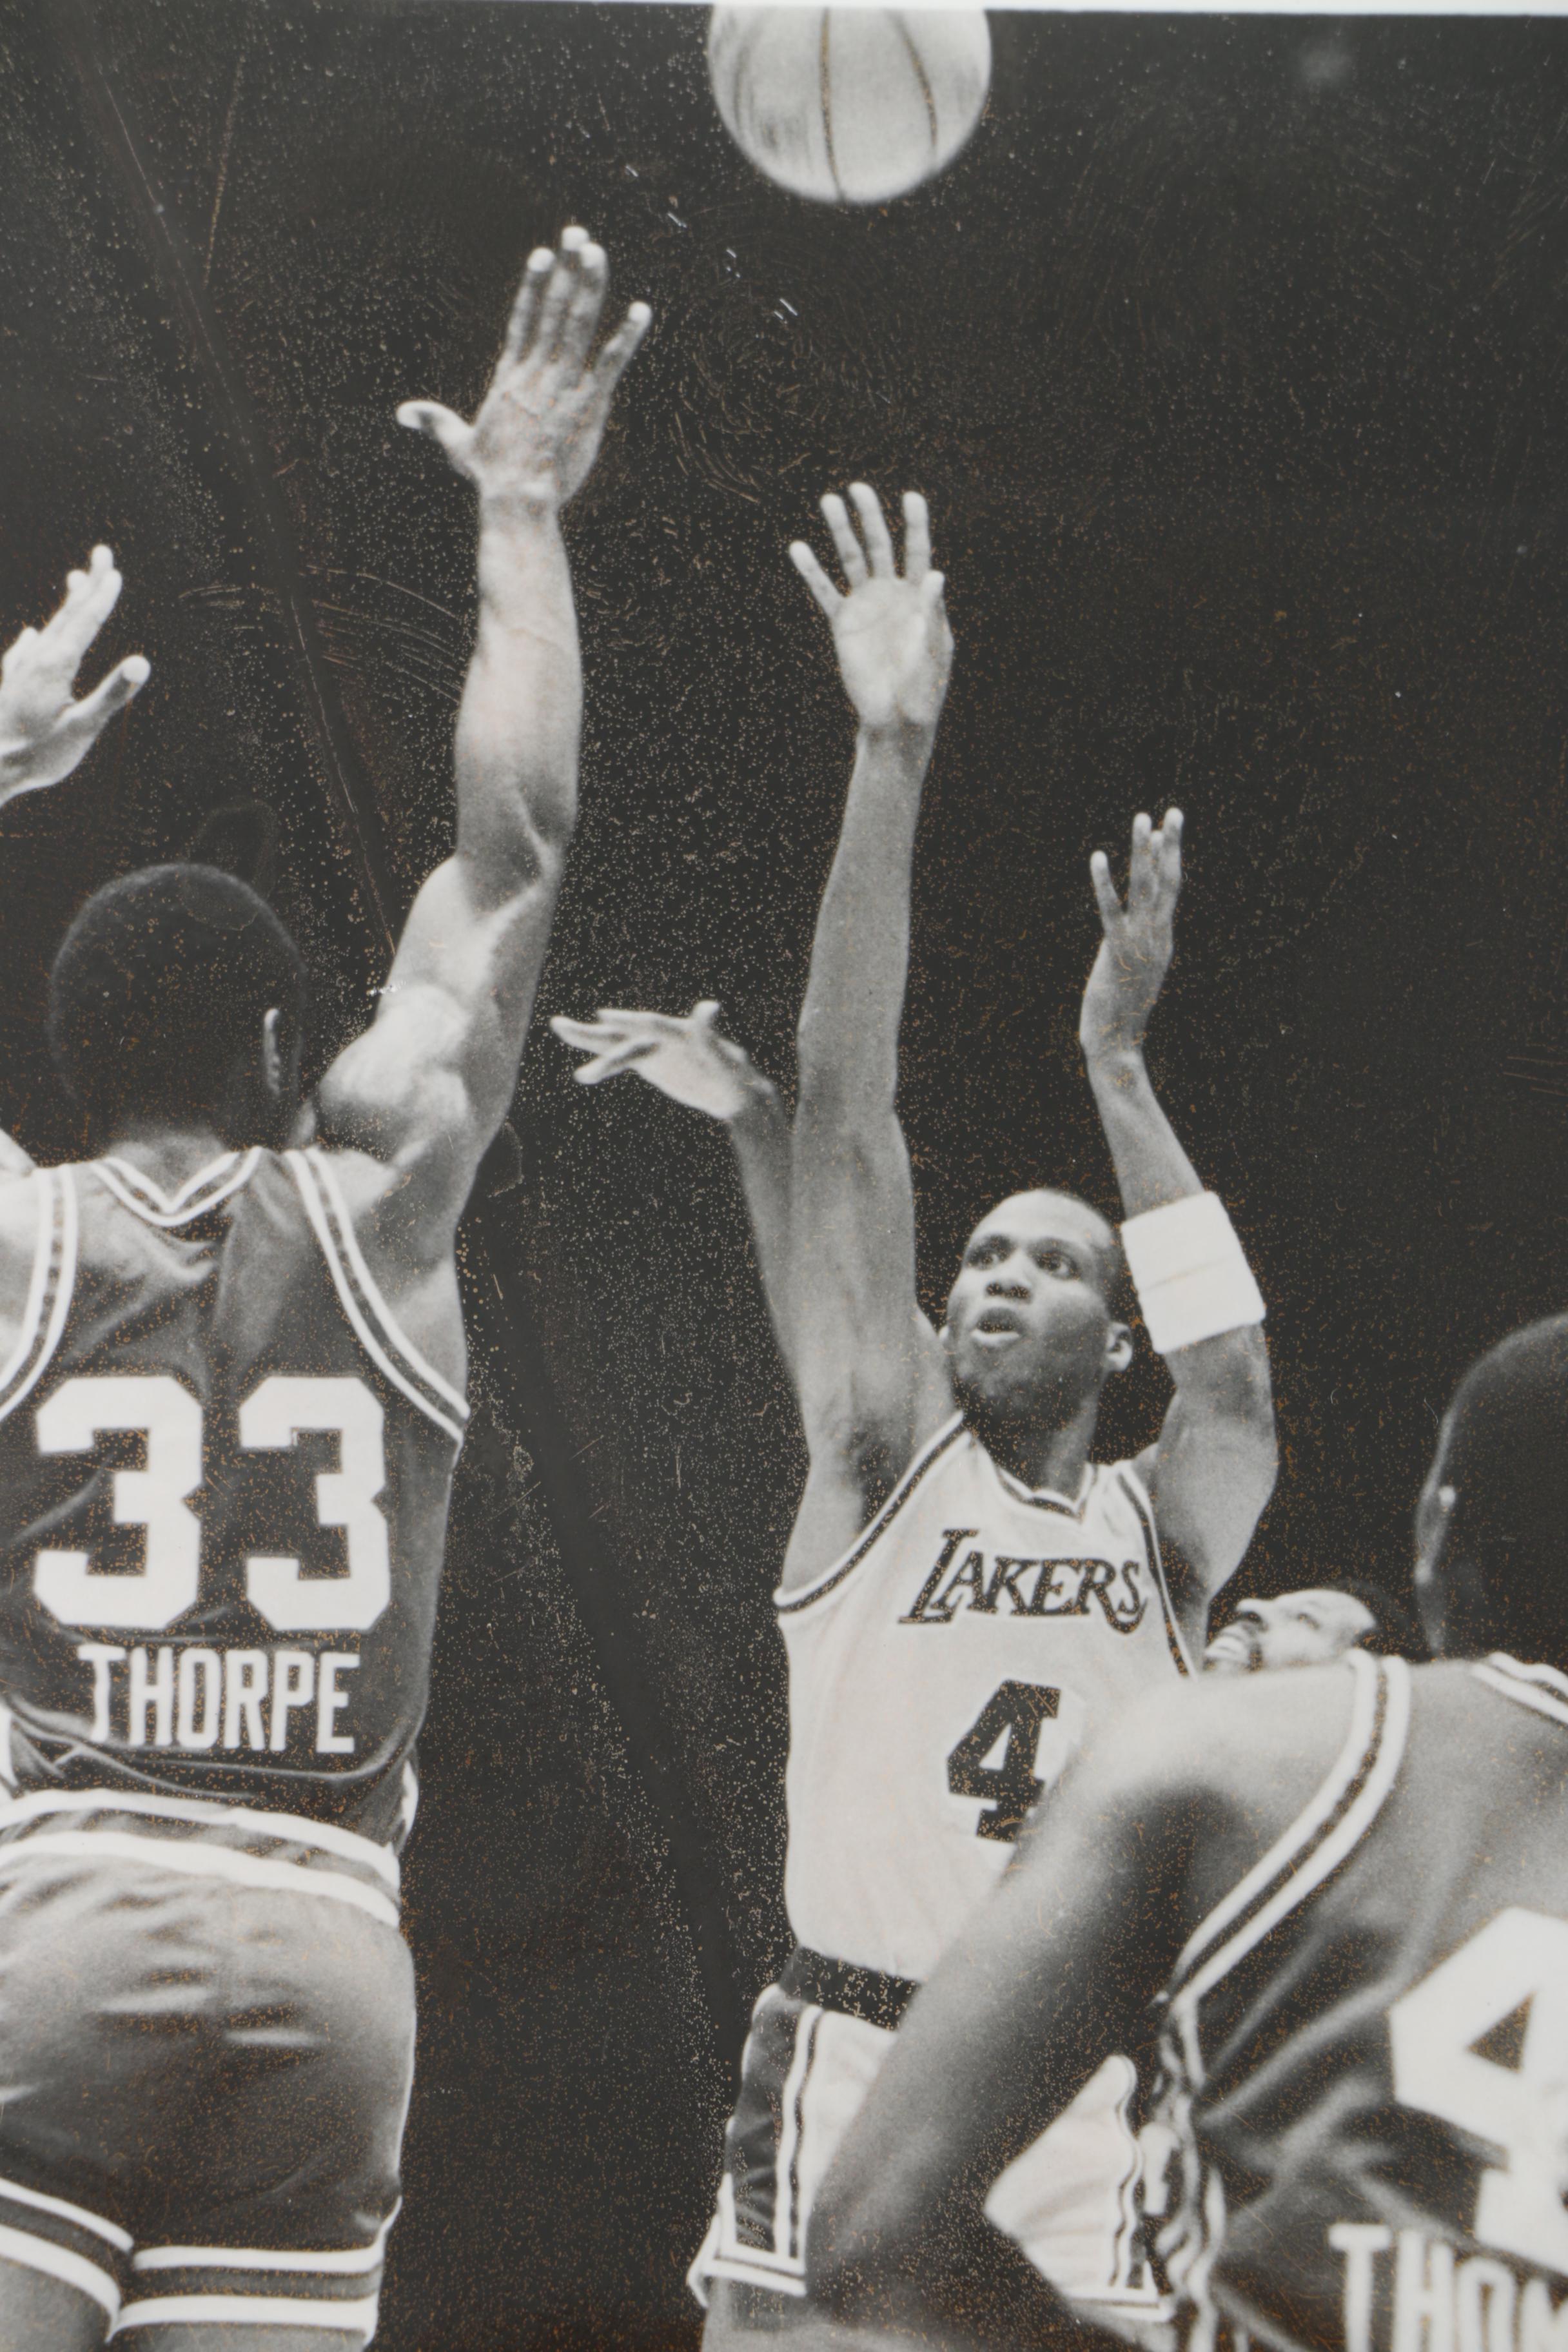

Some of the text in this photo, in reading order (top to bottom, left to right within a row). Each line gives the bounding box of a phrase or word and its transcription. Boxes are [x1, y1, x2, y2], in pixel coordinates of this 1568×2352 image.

[34, 1375, 391, 1632] 33
[897, 1528, 1149, 1634] LAKERS
[77, 1643, 360, 1754] THORPE
[946, 1678, 1061, 1843] 4
[1389, 1905, 1568, 2277] 4
